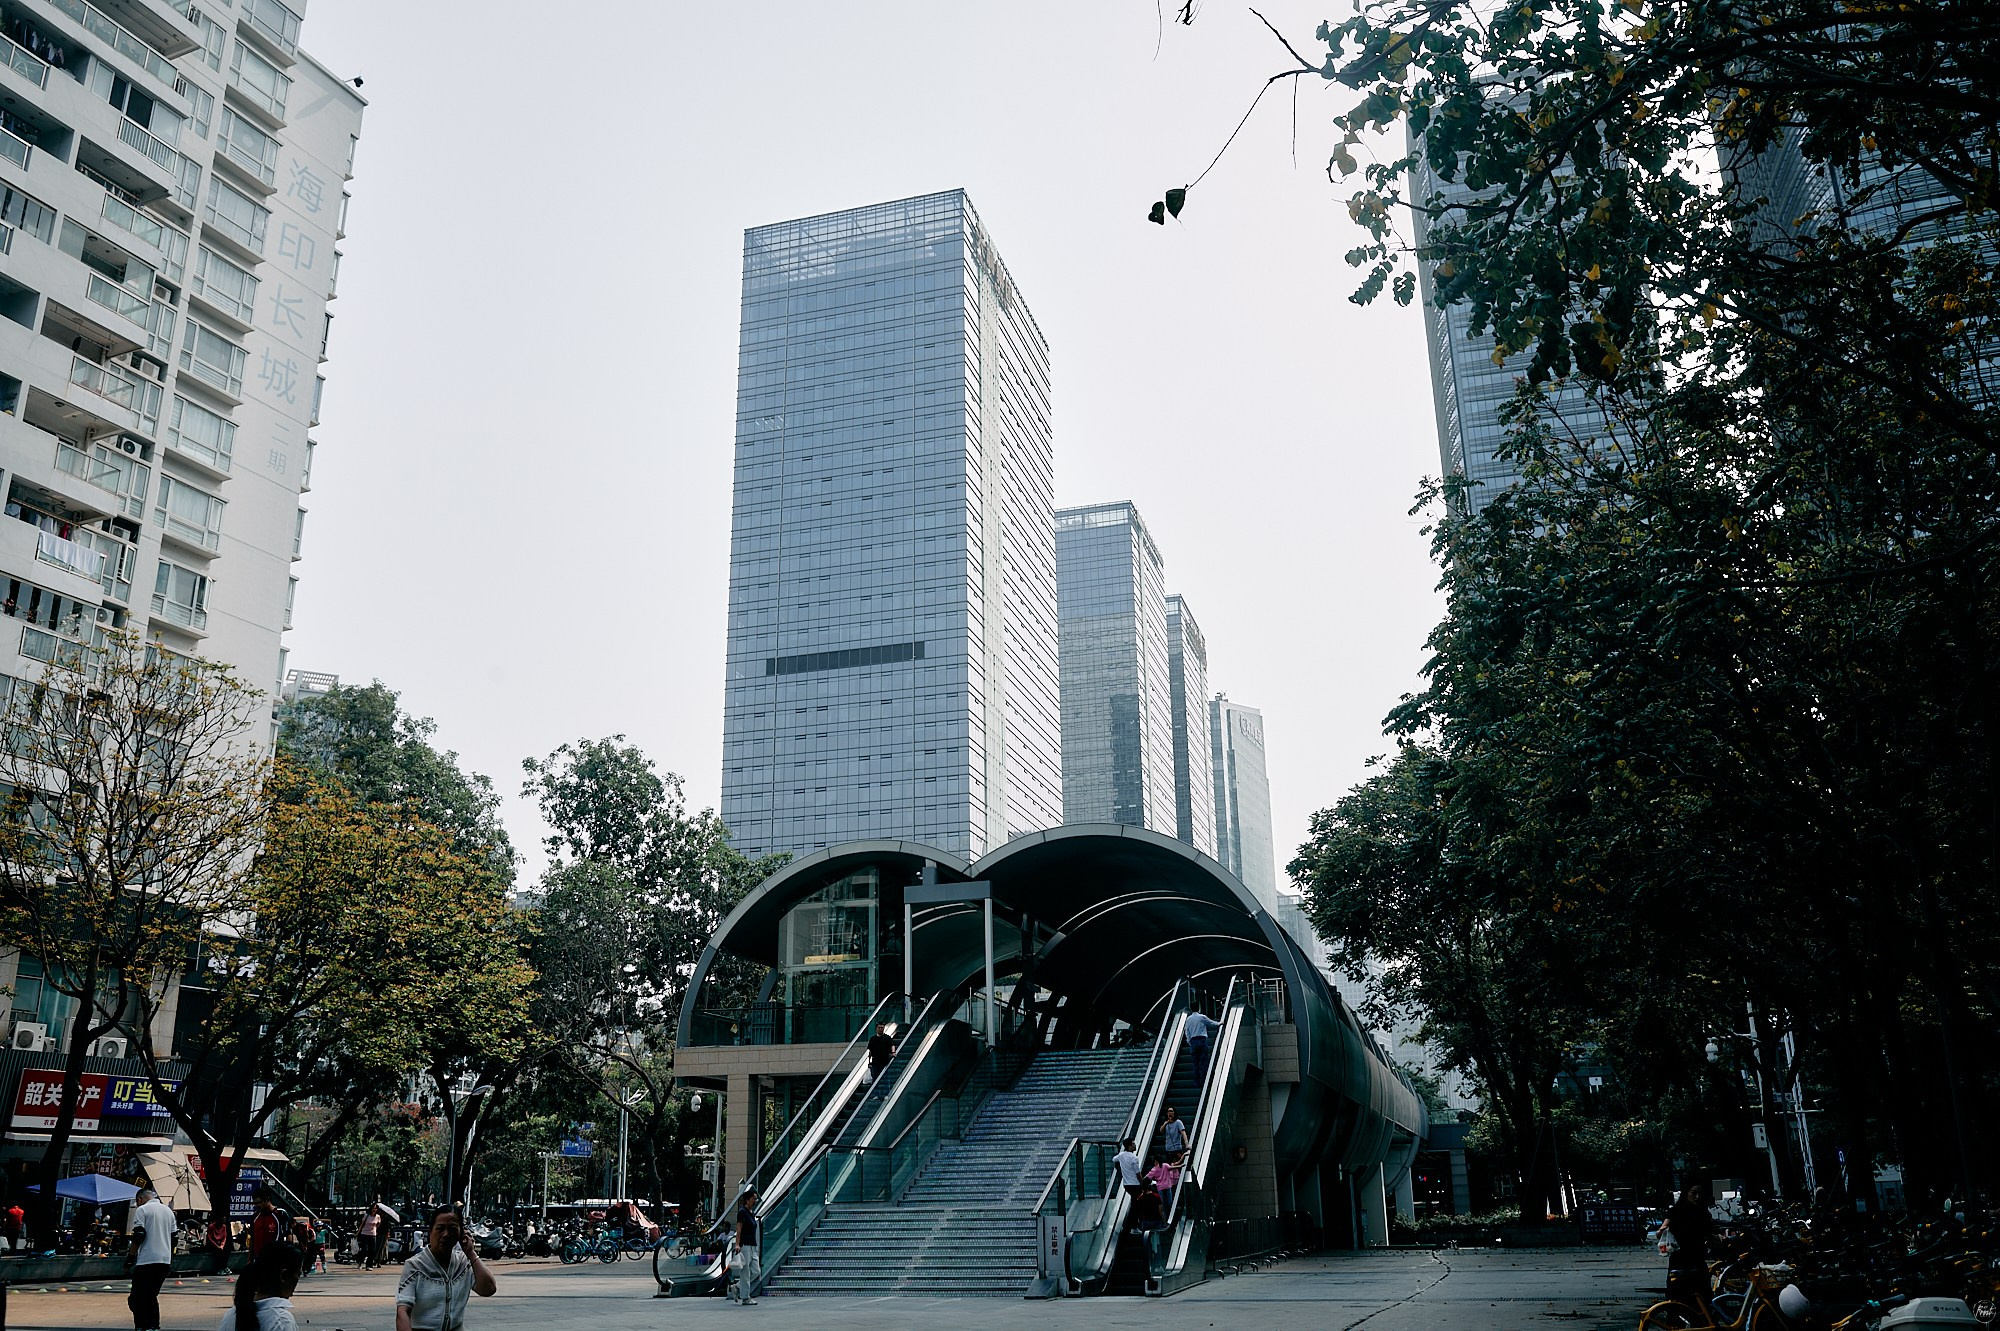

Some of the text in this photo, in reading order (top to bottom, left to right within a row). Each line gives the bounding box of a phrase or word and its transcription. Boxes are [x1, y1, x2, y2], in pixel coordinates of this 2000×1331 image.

[257, 156, 326, 474] 海印长城 二期
[1585, 1209, 1594, 1222] P
